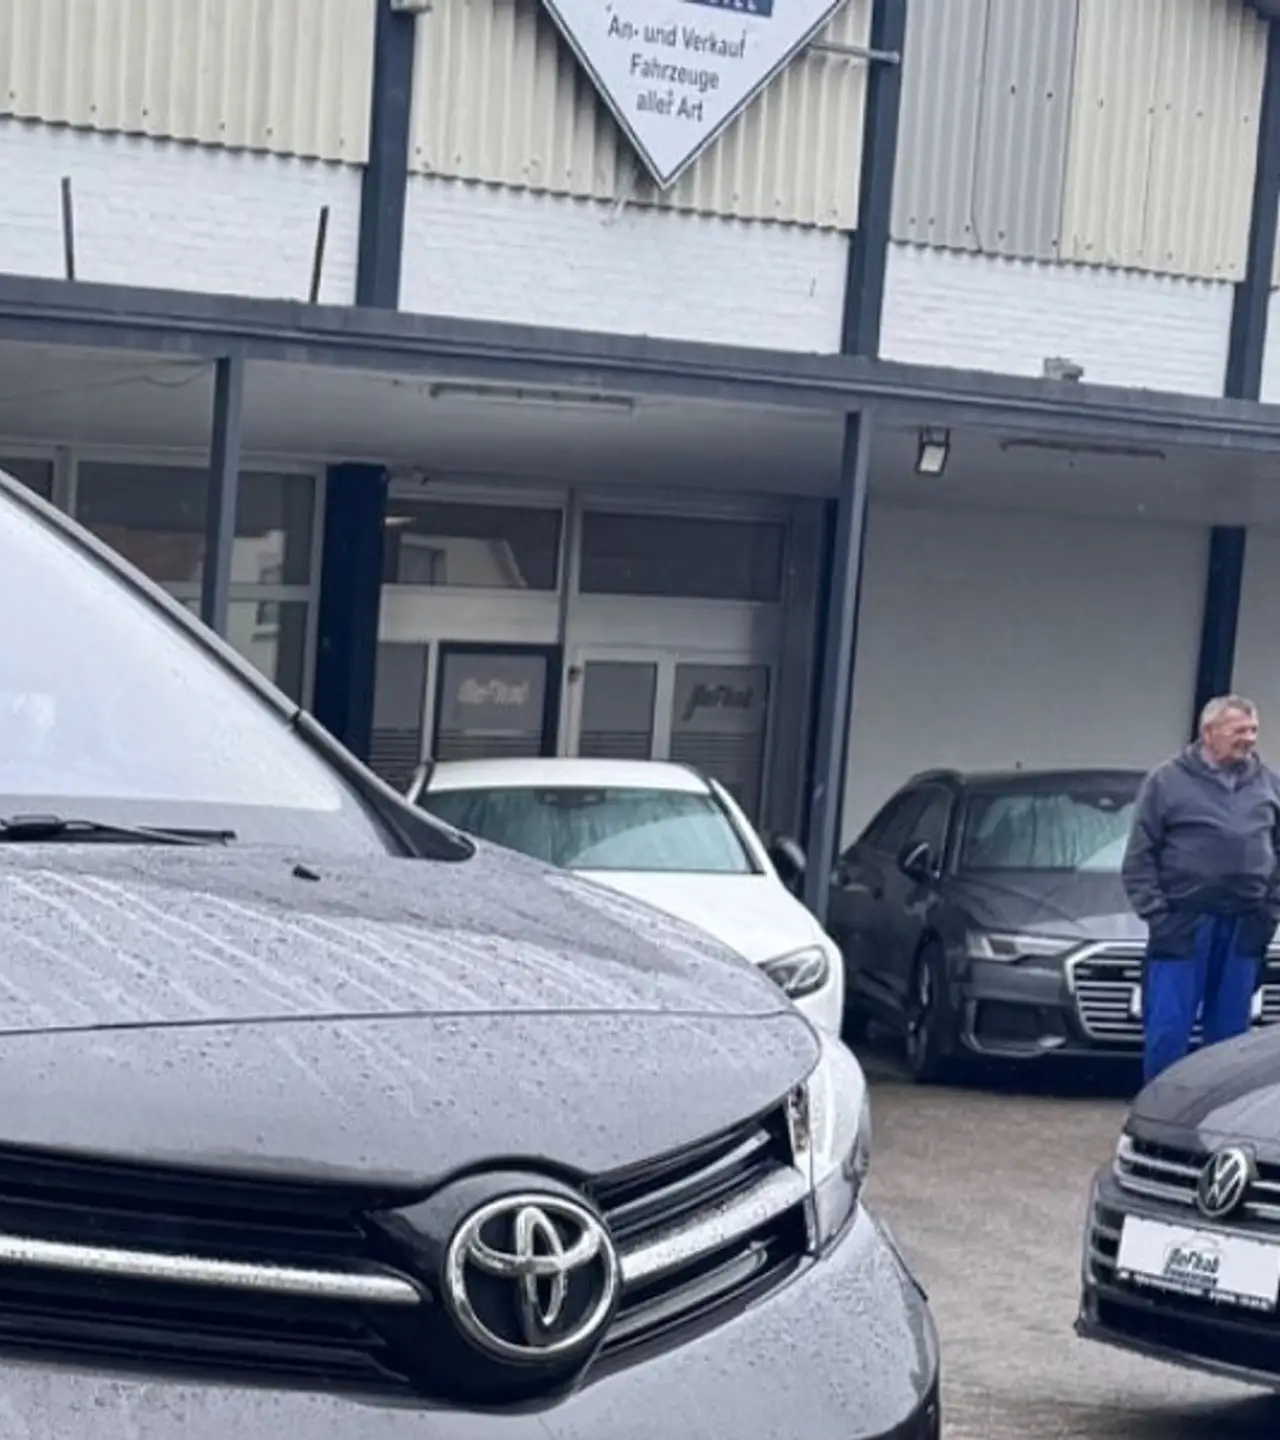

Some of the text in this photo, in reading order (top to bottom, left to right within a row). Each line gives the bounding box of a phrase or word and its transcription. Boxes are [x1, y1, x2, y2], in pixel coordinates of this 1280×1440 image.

[608, 14, 746, 58] An- und Verkauf
[630, 53, 720, 93] Fahrzeuge
[637, 92, 704, 121] aller Art
